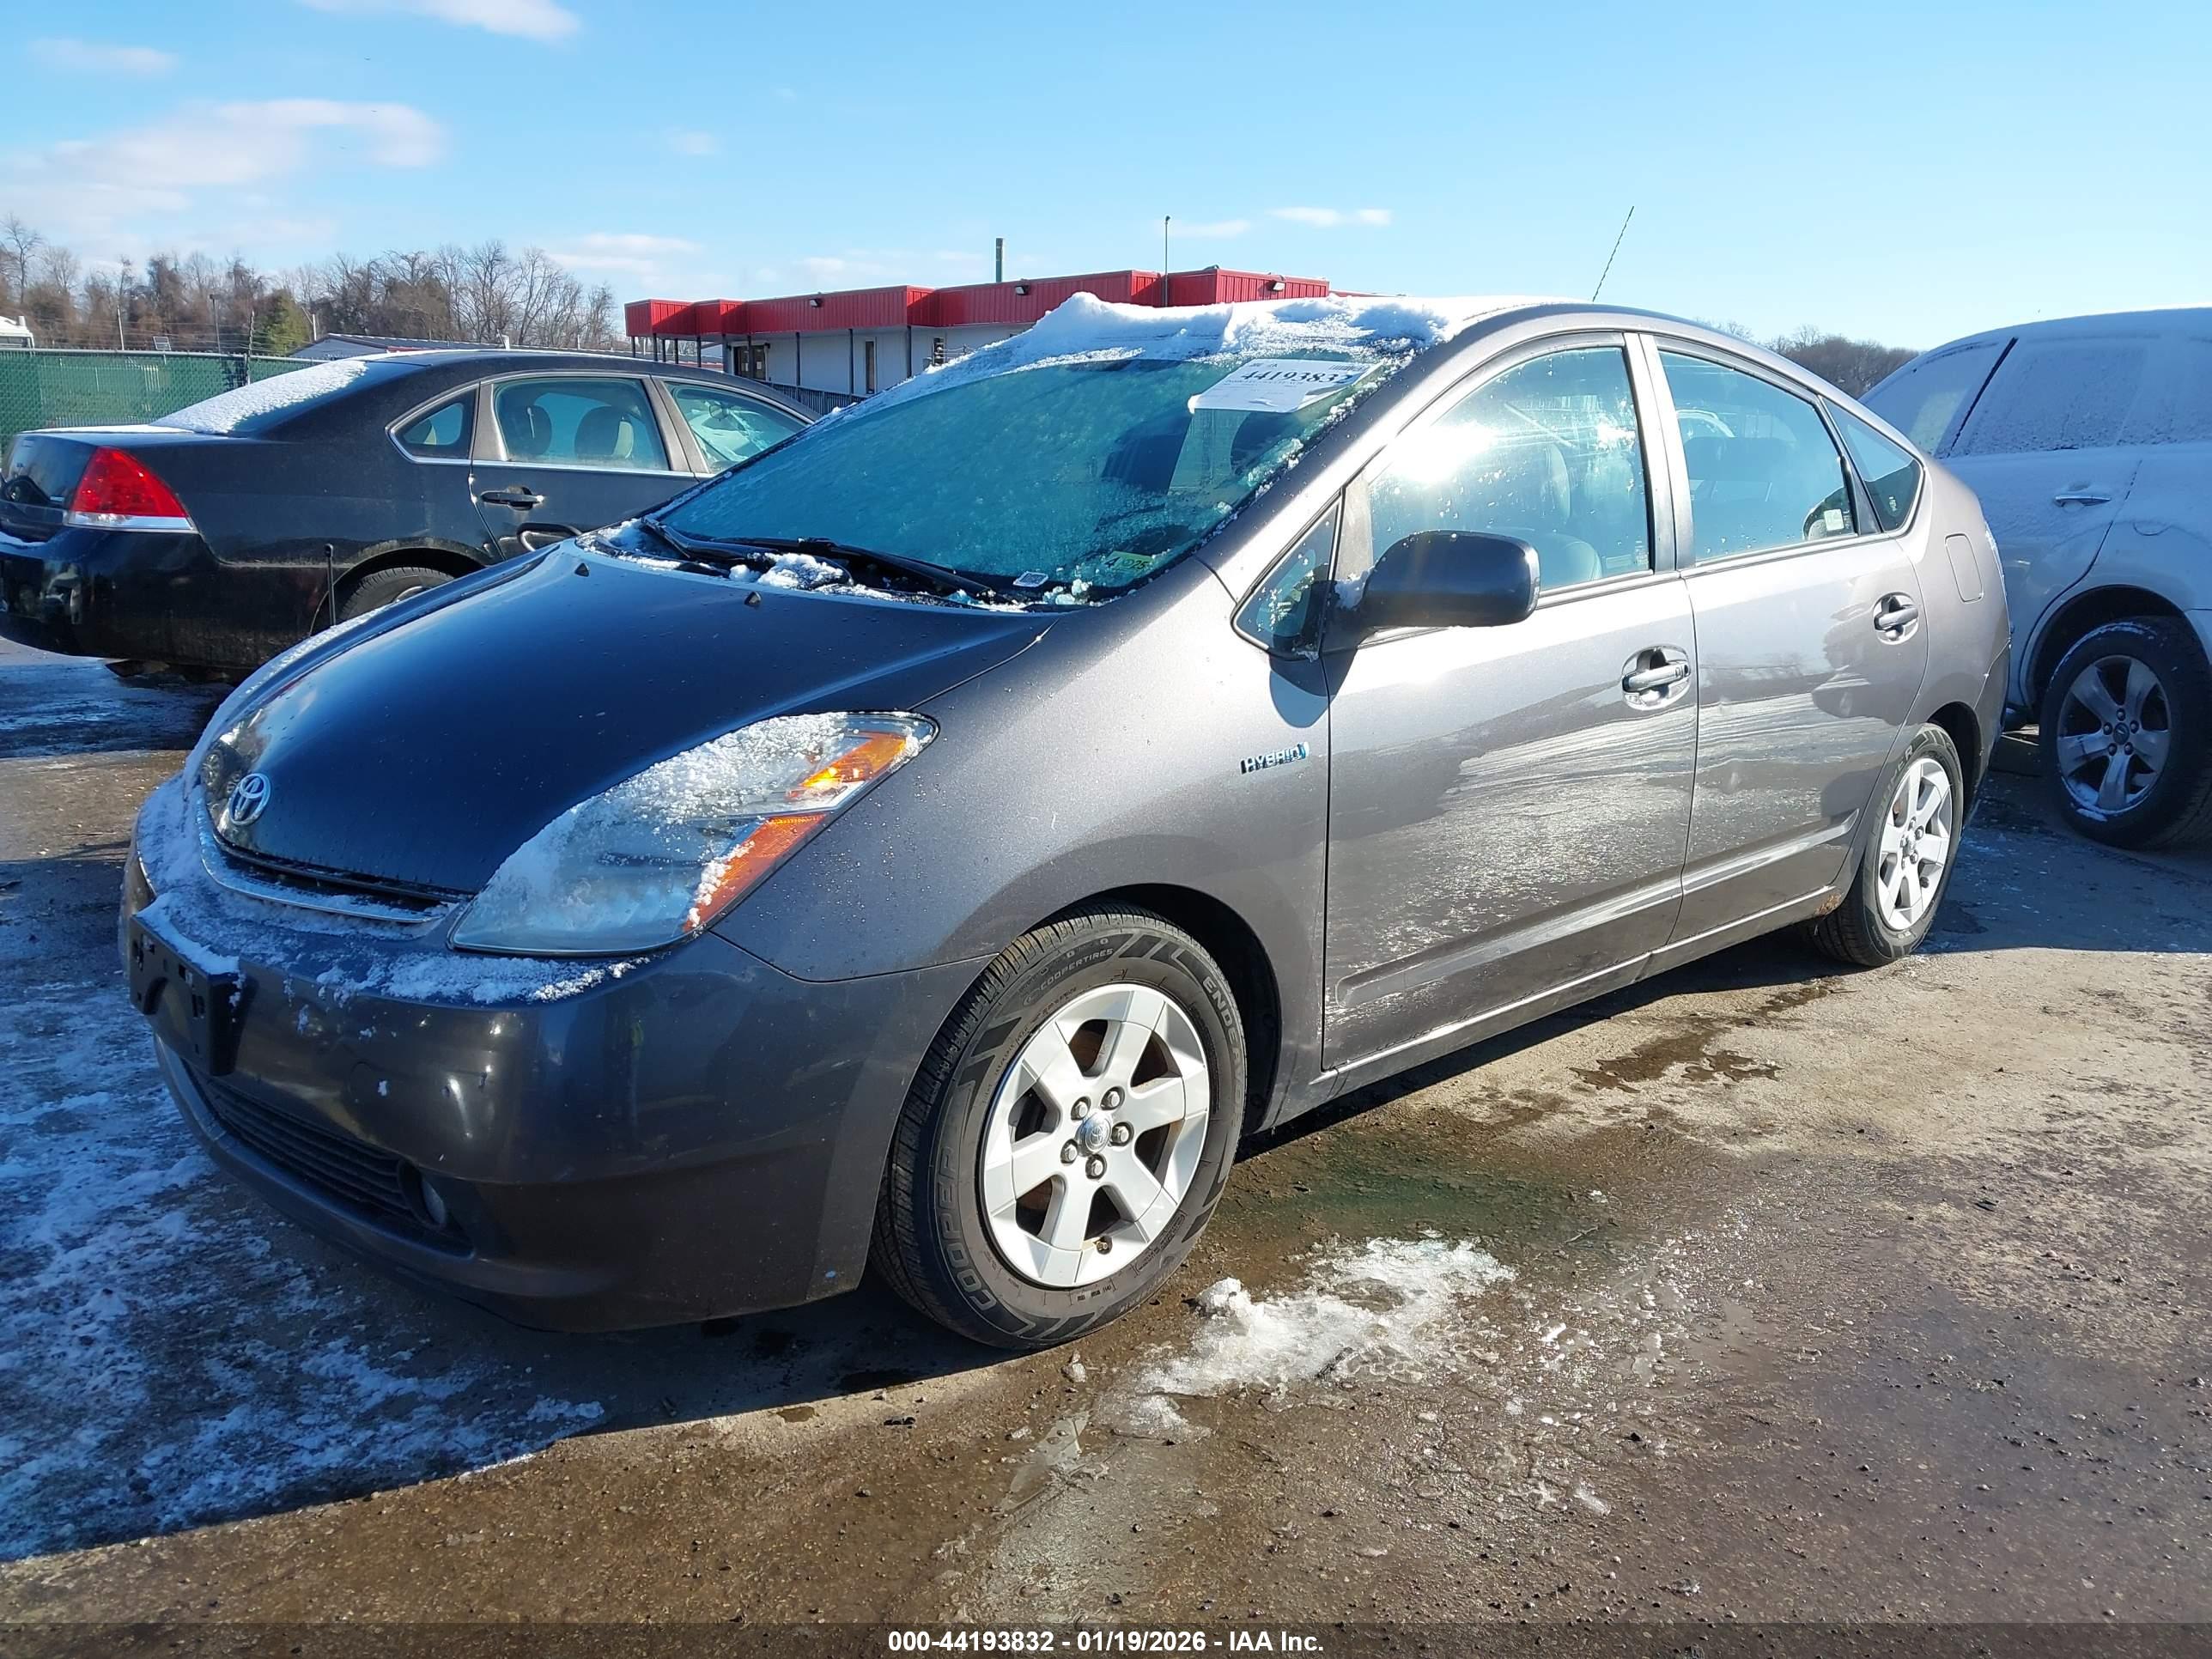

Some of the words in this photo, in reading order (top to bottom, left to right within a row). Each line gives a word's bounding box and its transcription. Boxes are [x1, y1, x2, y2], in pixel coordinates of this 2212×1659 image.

[1241, 370, 1353, 384] 44193832
[1239, 742, 1310, 775] HYBRID
[937, 1146, 997, 1311] COOPER
